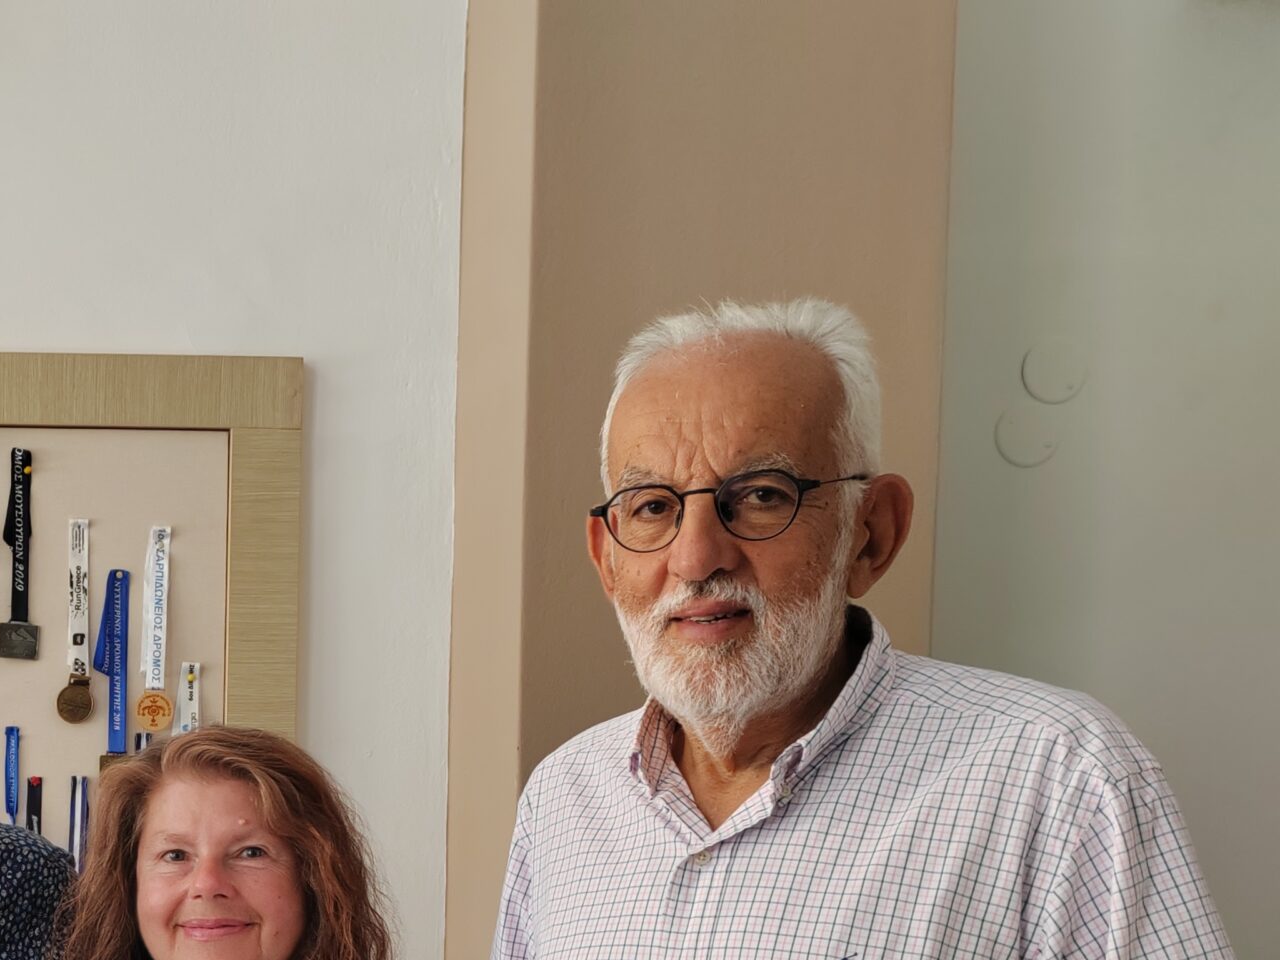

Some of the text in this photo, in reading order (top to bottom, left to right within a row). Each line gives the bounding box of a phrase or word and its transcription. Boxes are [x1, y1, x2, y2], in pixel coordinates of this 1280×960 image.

[14, 561, 24, 591] 2019
[74, 565, 82, 610] RunGreece
[153, 549, 164, 630] ΣΑΡΠΙΔΩΝΕΙΟΣ
[112, 637, 121, 673] ΔΡΟΜΟΣ
[151, 634, 162, 683] ΔΡΟΜΟΣ
[112, 675, 120, 710] ΚΡΗΤΗΣ
[112, 712, 120, 730] 2018
